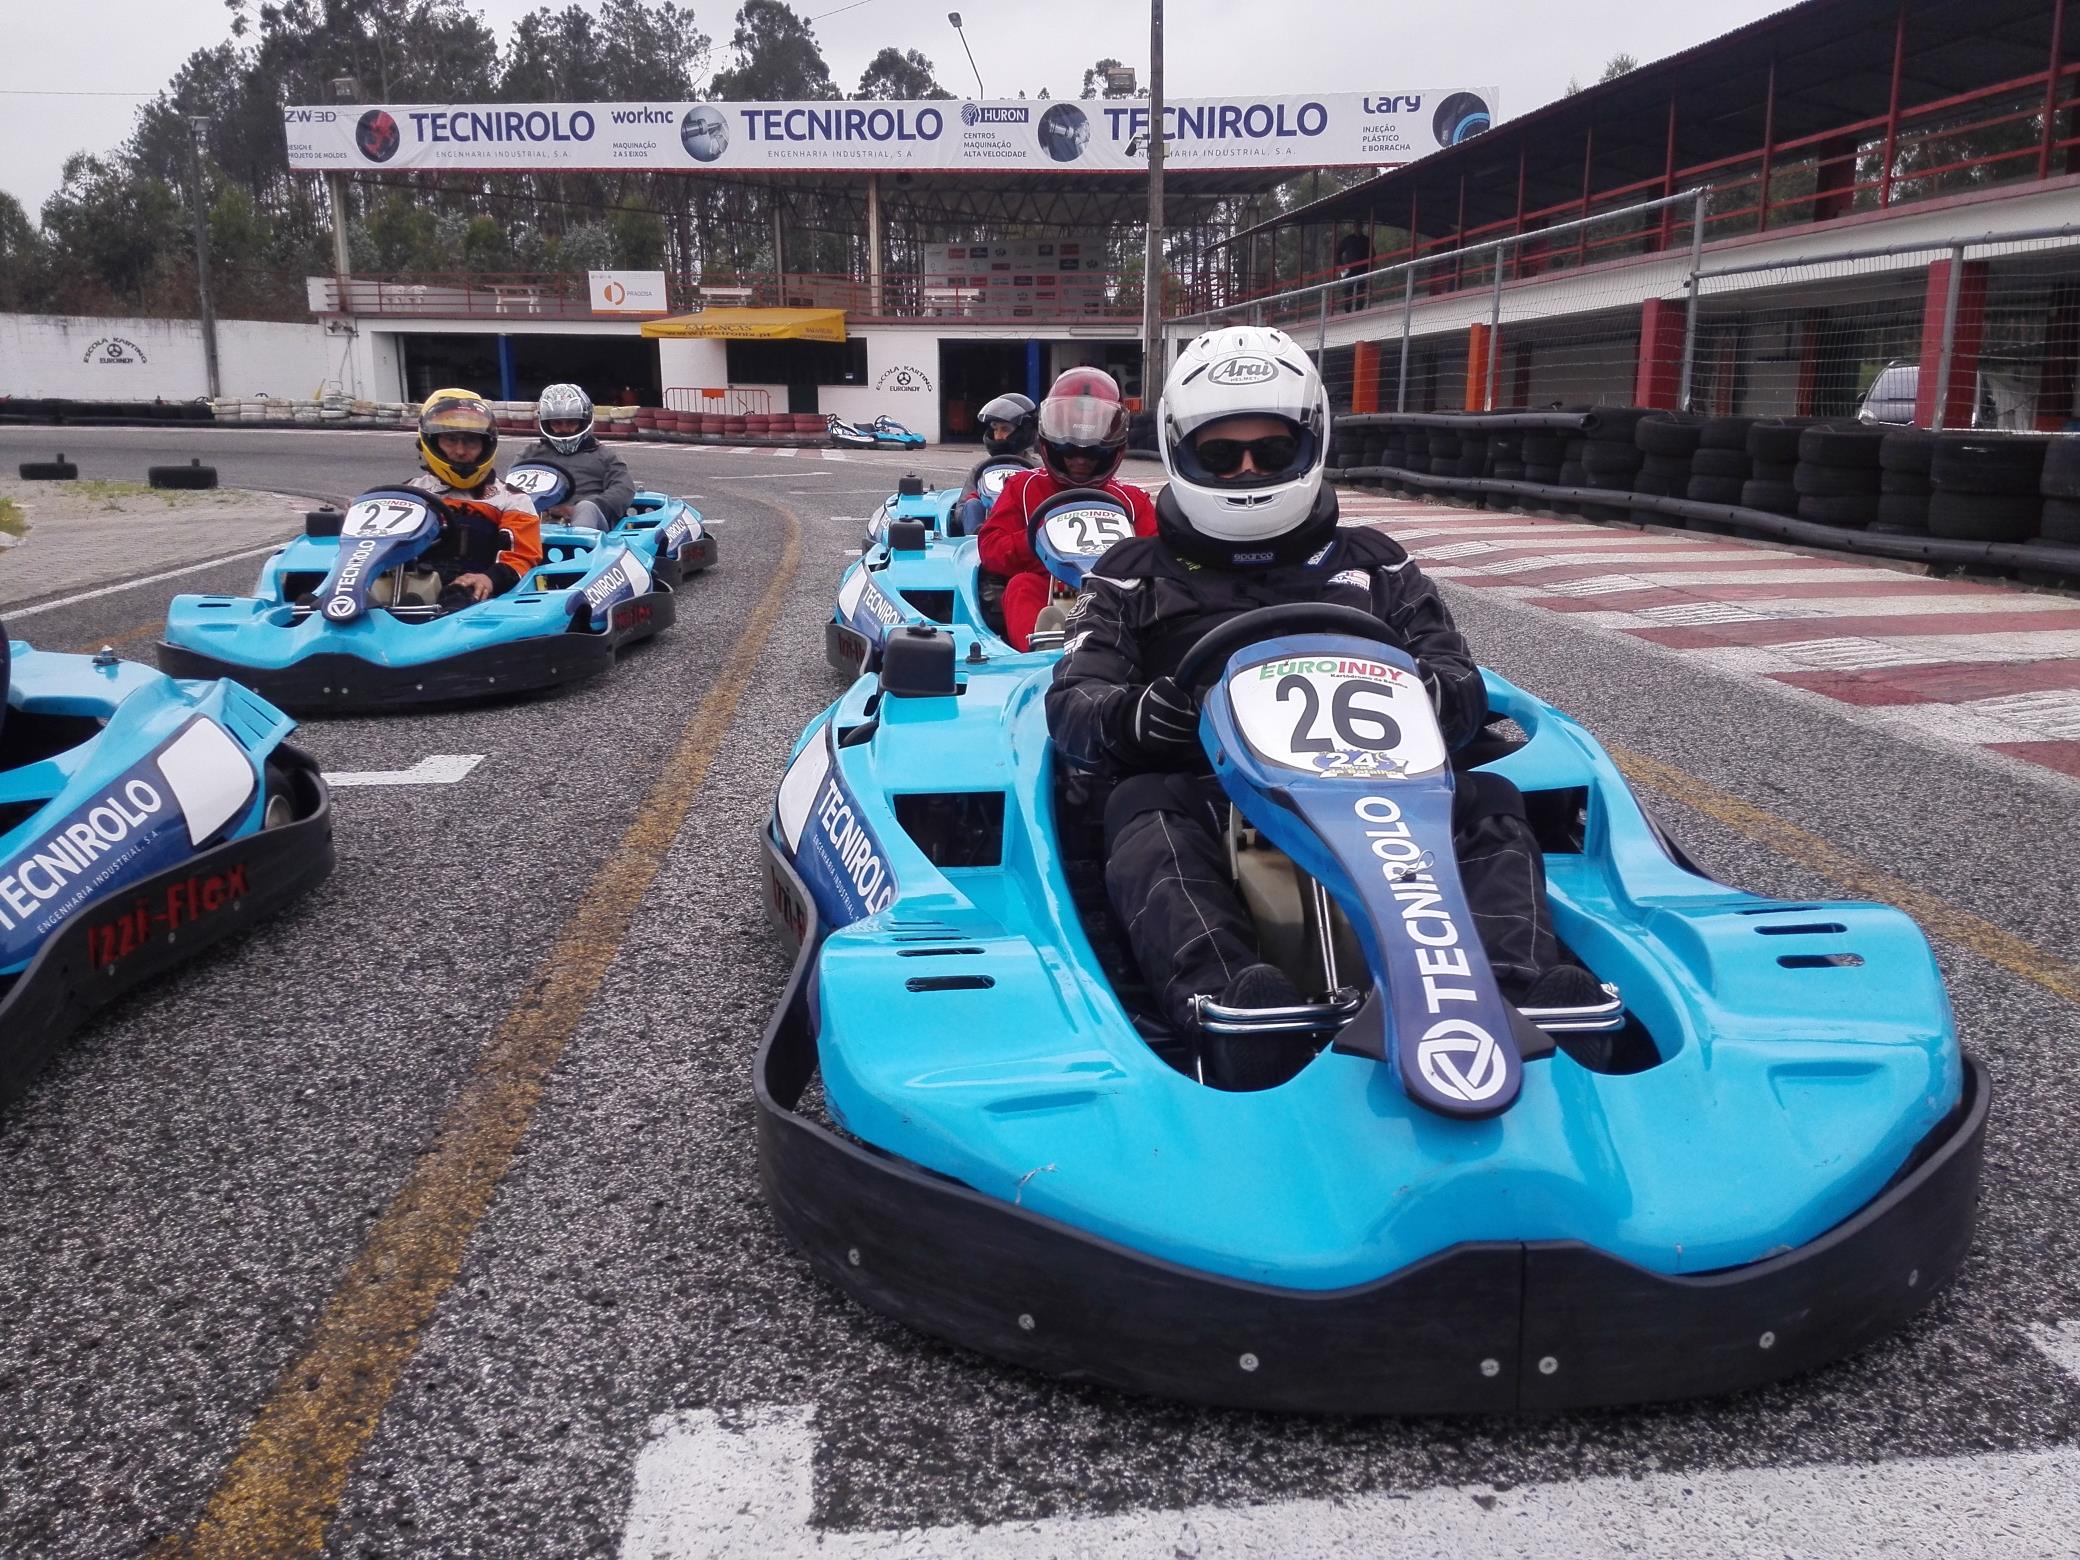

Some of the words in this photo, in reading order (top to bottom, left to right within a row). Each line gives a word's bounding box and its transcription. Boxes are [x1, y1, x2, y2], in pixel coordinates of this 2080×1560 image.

[611, 106, 674, 124] worknc
[740, 108, 944, 142] TECNIROLO
[984, 109, 1025, 121] HURON
[408, 110, 596, 142] TECNIROLO
[963, 132, 996, 140] CENTROS
[1362, 124, 1396, 134] INJEÇÃO
[612, 141, 657, 150] MAQUINAÇÃO
[963, 141, 1012, 149] MAQUINAÇÃO
[1362, 135, 1400, 143] PLÁSTICO
[1368, 144, 1411, 152] BORRACHA
[767, 150, 828, 158] ENGENHARIA
[83, 338, 109, 364] ESCOLA
[112, 337, 148, 364] KARTING
[876, 366, 900, 391] ESCOLA
[903, 365, 933, 392] KARTING
[1213, 360, 1272, 380] Arai
[516, 473, 540, 490] 24
[360, 503, 414, 531] 27
[1056, 511, 1118, 523] EUROINDY
[1068, 516, 1126, 547] 25
[1233, 552, 1275, 561] sparco
[335, 540, 376, 596] TECNIROLO
[585, 567, 626, 609] CNIROLO
[863, 583, 905, 625] TECNIRO
[1259, 660, 1403, 681] EUROINDY
[1275, 673, 1402, 754] 26
[1325, 751, 1379, 769] 24
[36, 884, 95, 934] ENGENHARIA
[1354, 795, 1479, 1014] TECNIROLO
